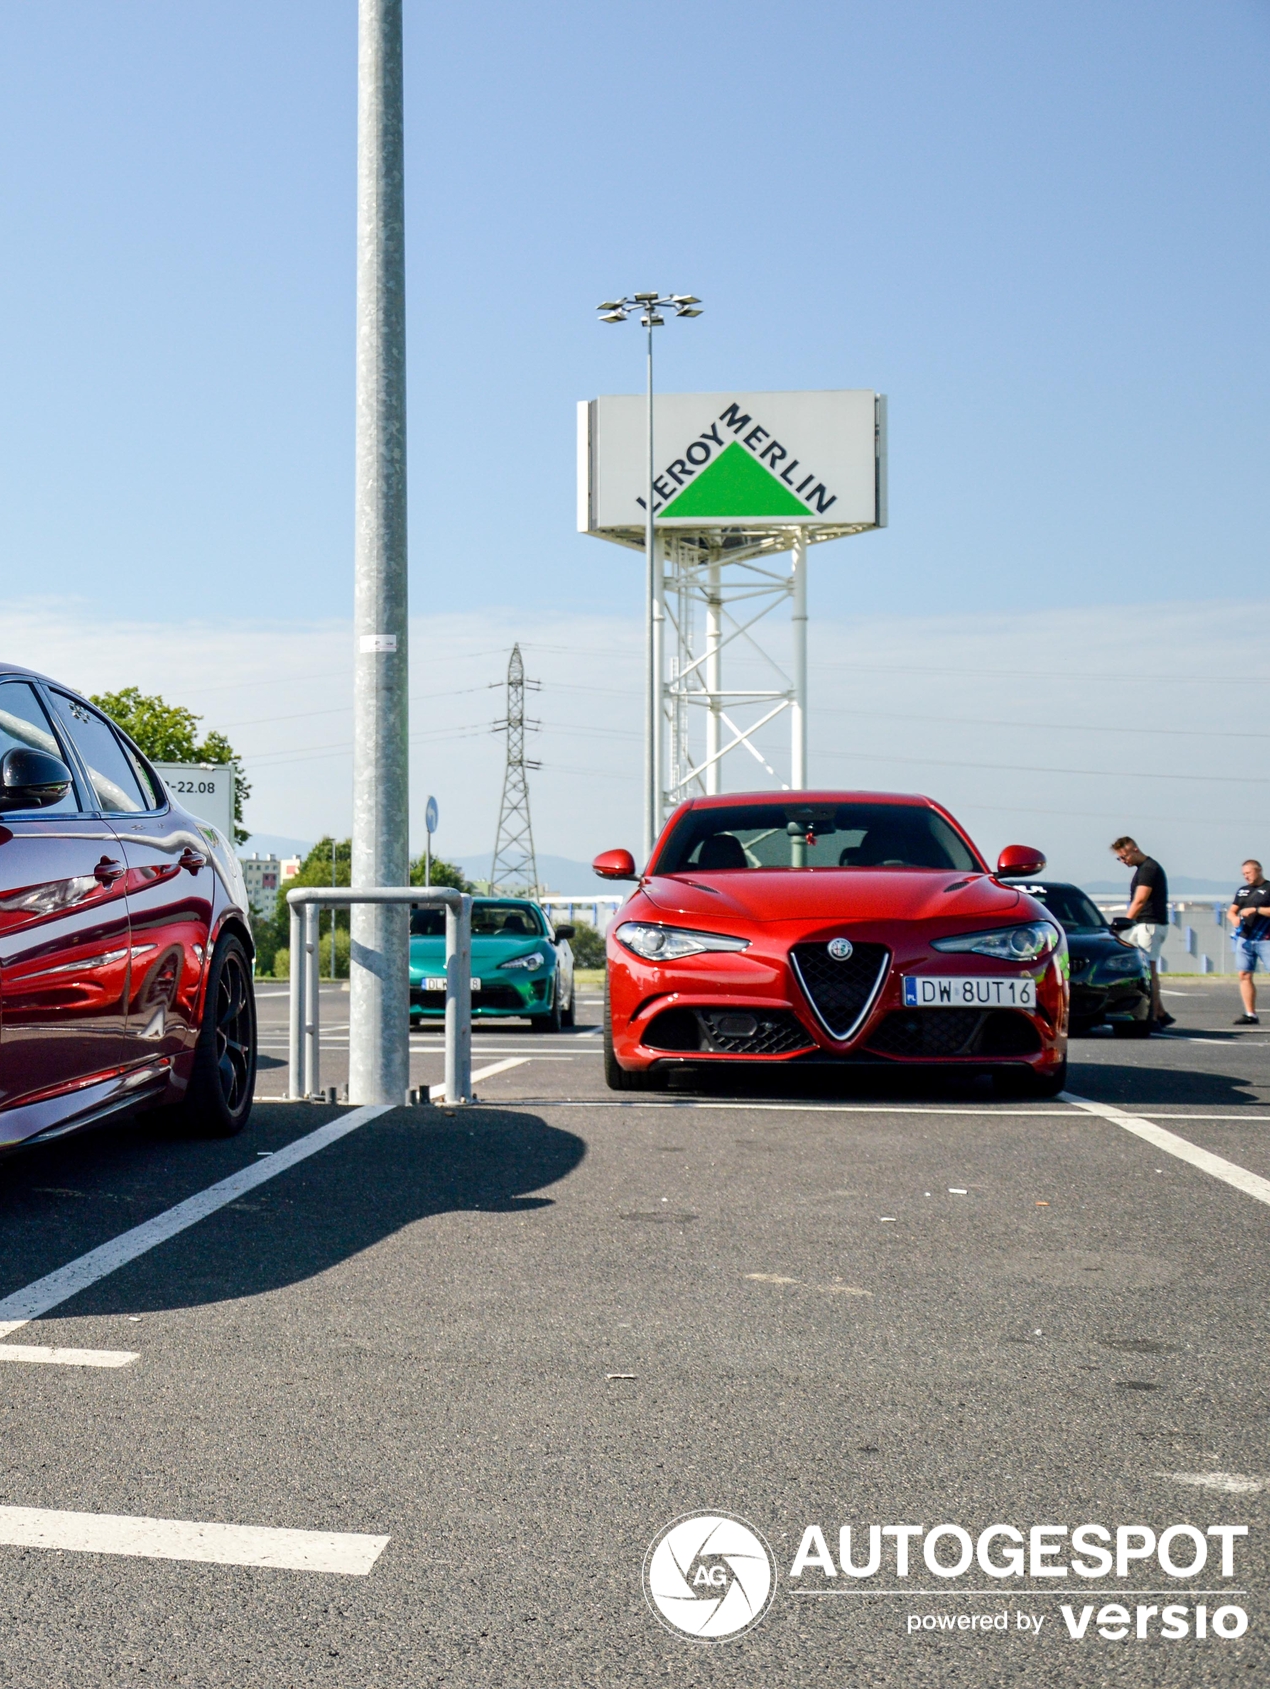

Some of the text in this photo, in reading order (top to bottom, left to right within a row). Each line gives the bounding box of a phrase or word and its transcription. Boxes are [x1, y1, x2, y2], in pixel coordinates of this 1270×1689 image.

[636, 402, 837, 514] LEROY MERLIN
[922, 981, 1030, 1004] DW 8UT16
